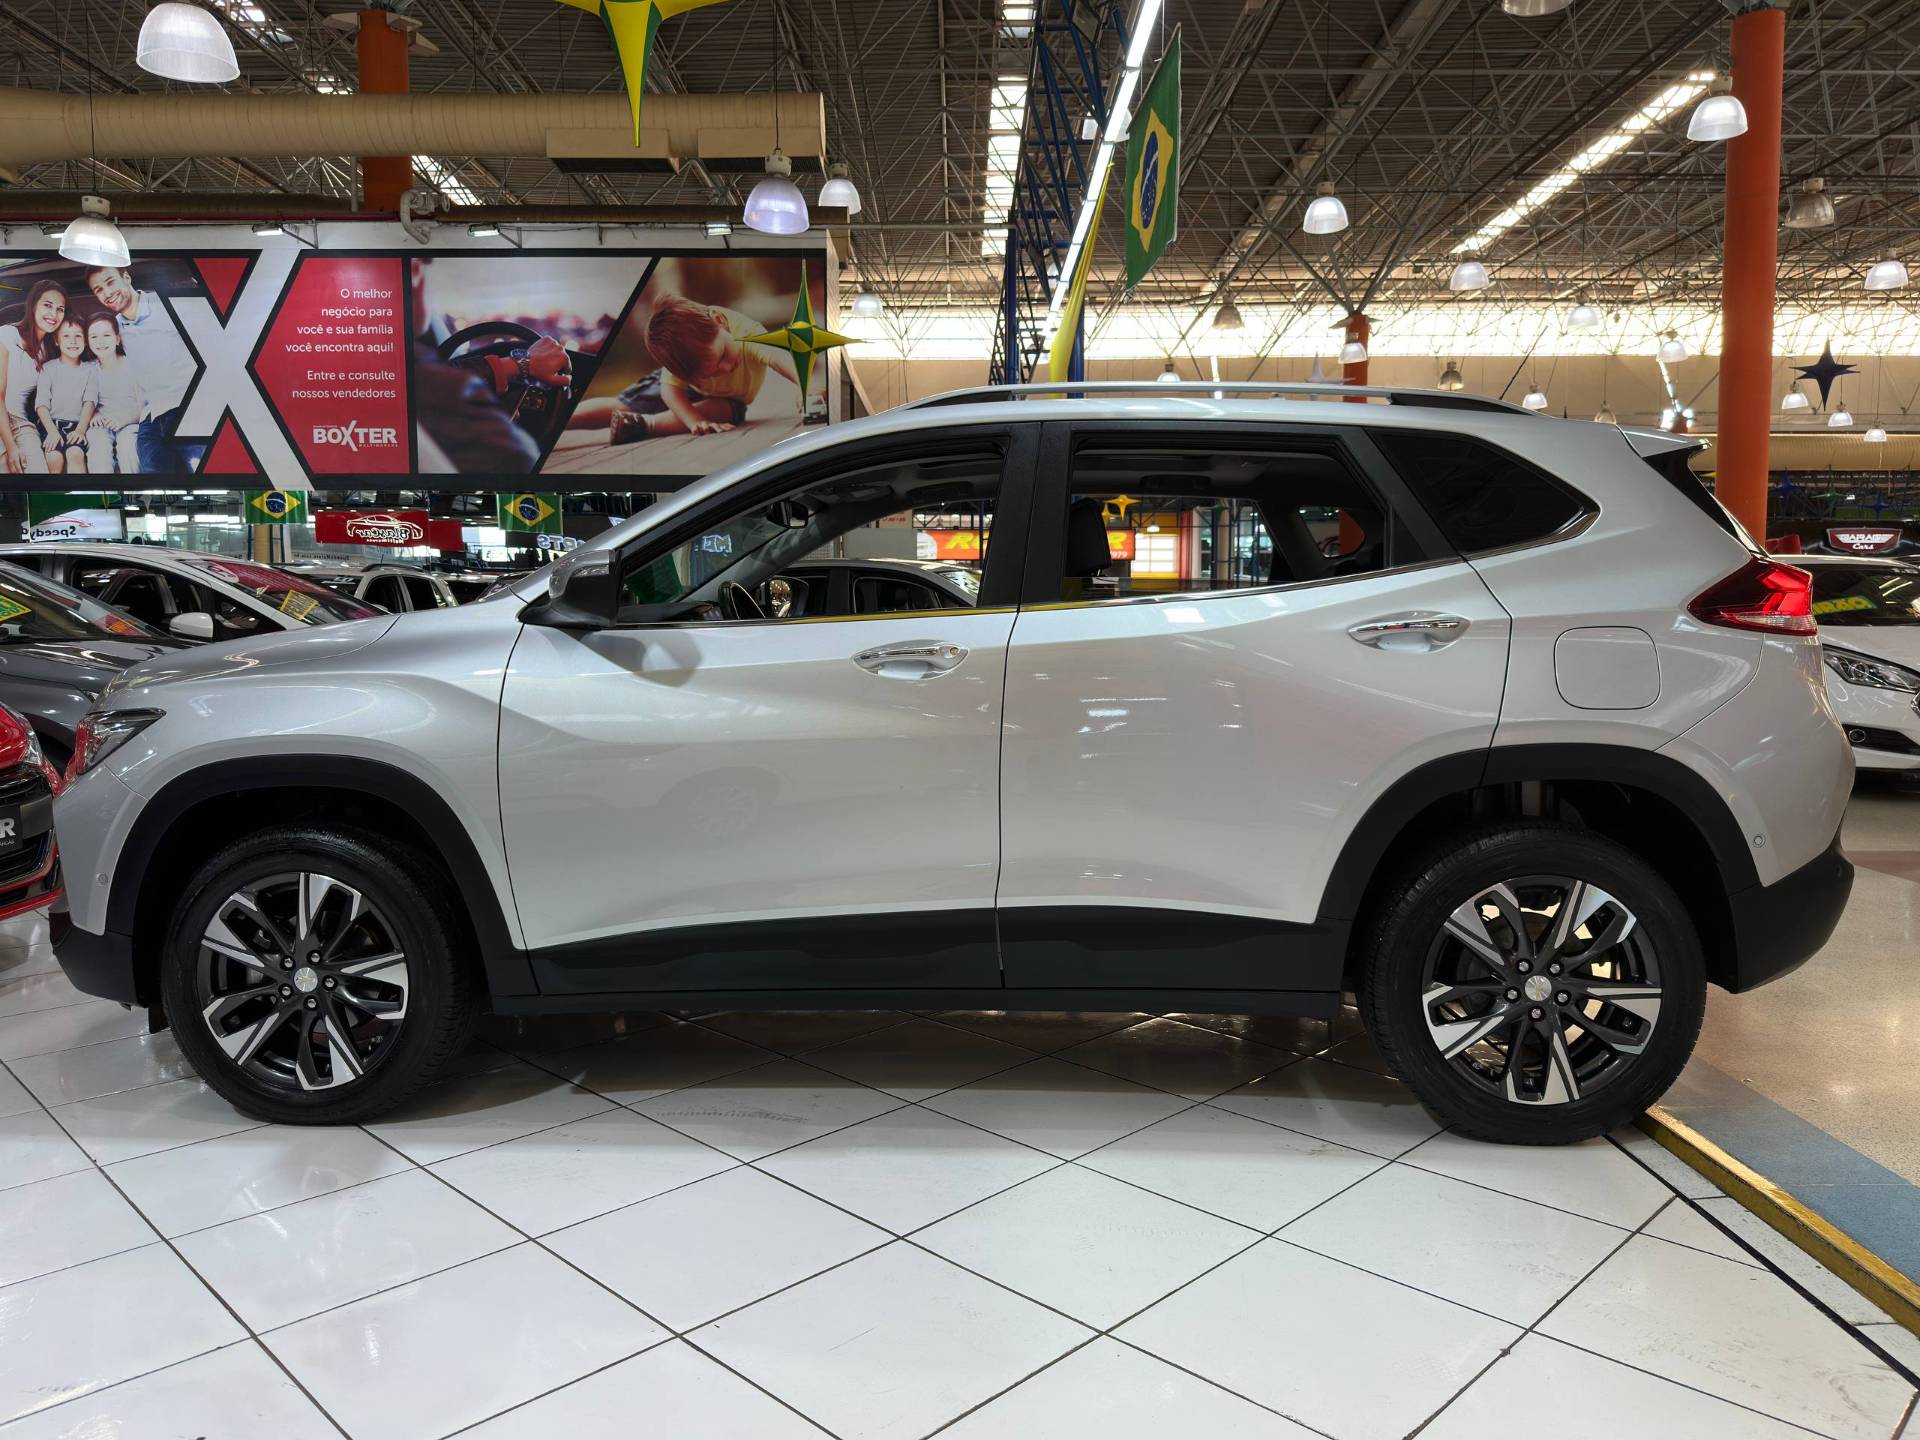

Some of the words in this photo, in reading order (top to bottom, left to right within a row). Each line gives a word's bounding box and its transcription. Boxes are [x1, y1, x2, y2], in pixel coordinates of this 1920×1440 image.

[340, 288, 350, 299] O
[353, 288, 393, 299] melhor
[321, 306, 366, 319] negócio
[369, 308, 393, 318] para
[297, 324, 324, 335] você
[326, 326, 333, 335] e
[336, 326, 355, 335] sua
[357, 323, 394, 335] família
[285, 342, 312, 353] você
[315, 343, 364, 353] encontra
[367, 342, 394, 355] aqui!
[307, 370, 336, 381] Entre
[338, 373, 346, 381] e
[348, 370, 396, 381] consulte
[292, 389, 330, 399] nossos
[333, 388, 396, 399] vendedores
[312, 420, 398, 452] BOXTER
